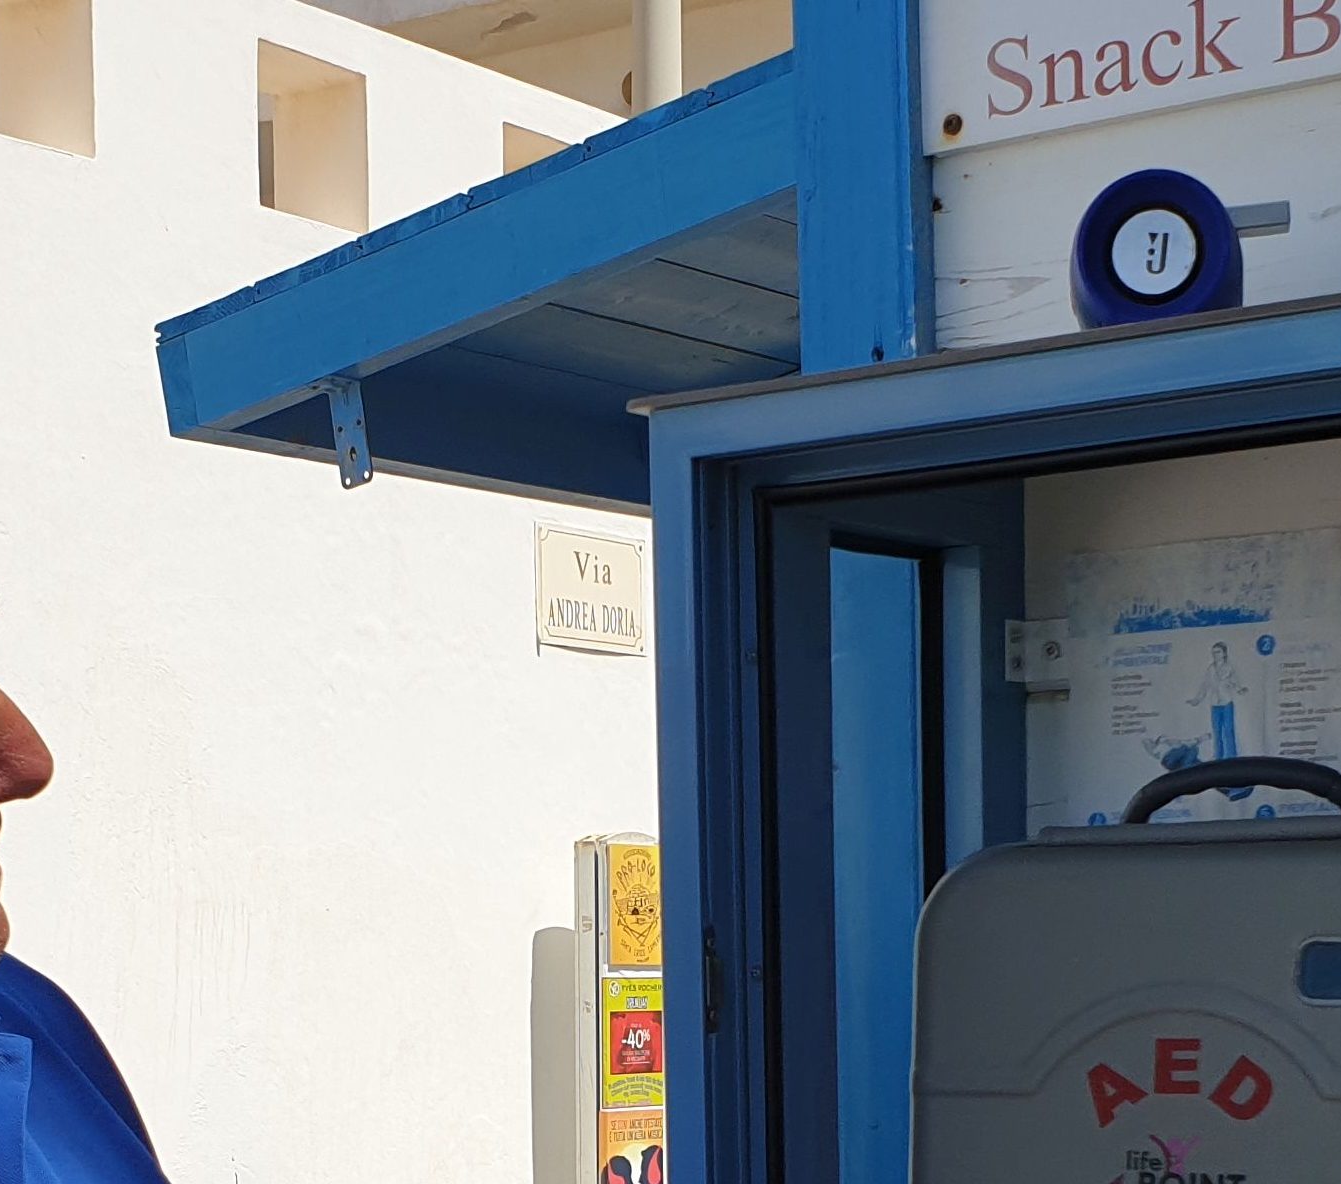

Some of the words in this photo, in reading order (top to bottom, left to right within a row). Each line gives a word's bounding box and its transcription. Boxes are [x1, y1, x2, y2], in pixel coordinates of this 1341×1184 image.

[986, 0, 1243, 119] Snack
[573, 551, 612, 585] Via
[548, 597, 597, 632] ANDREA
[602, 604, 636, 638] DORIA
[621, 1028, 651, 1049] -40%
[1086, 1037, 1274, 1129] AED
[1125, 1149, 1163, 1171] life
